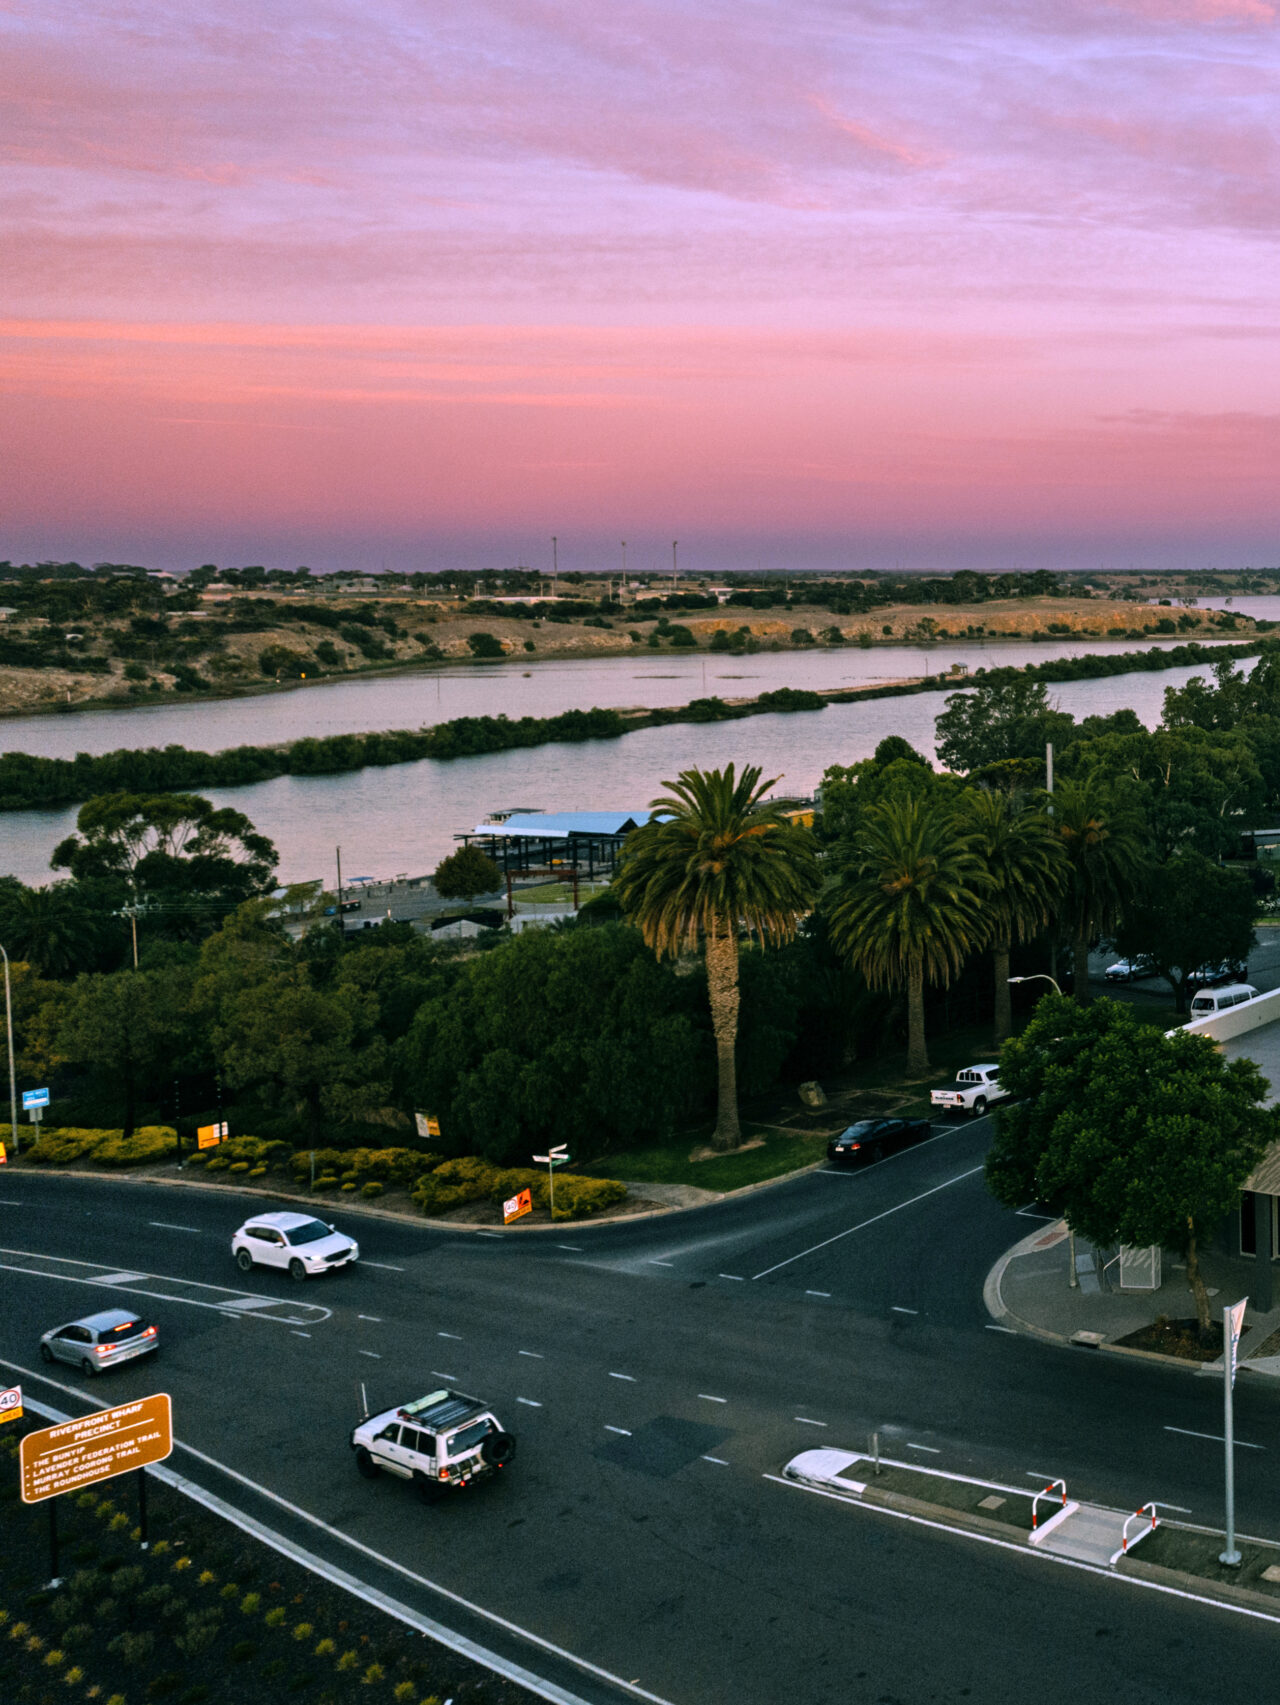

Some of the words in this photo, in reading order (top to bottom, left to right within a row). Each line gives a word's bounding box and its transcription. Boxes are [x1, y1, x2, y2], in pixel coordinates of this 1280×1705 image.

[1, 1394, 17, 1405] 40
[49, 1414, 109, 1439] RIVERFRONT
[111, 1404, 144, 1419] WHARF
[74, 1420, 121, 1441] PRECINCT
[33, 1457, 80, 1478] LAVENDER
[81, 1440, 135, 1462] FEDERATION
[137, 1432, 162, 1444] TRAIL
[33, 1457, 50, 1467] THE
[52, 1446, 86, 1462] BUNYIP
[33, 1469, 71, 1487] MURRAY
[73, 1455, 113, 1473] COORONG
[116, 1447, 141, 1459] TRAIL
[34, 1485, 51, 1495] THE
[53, 1465, 111, 1489] ROUNDHOUSE
